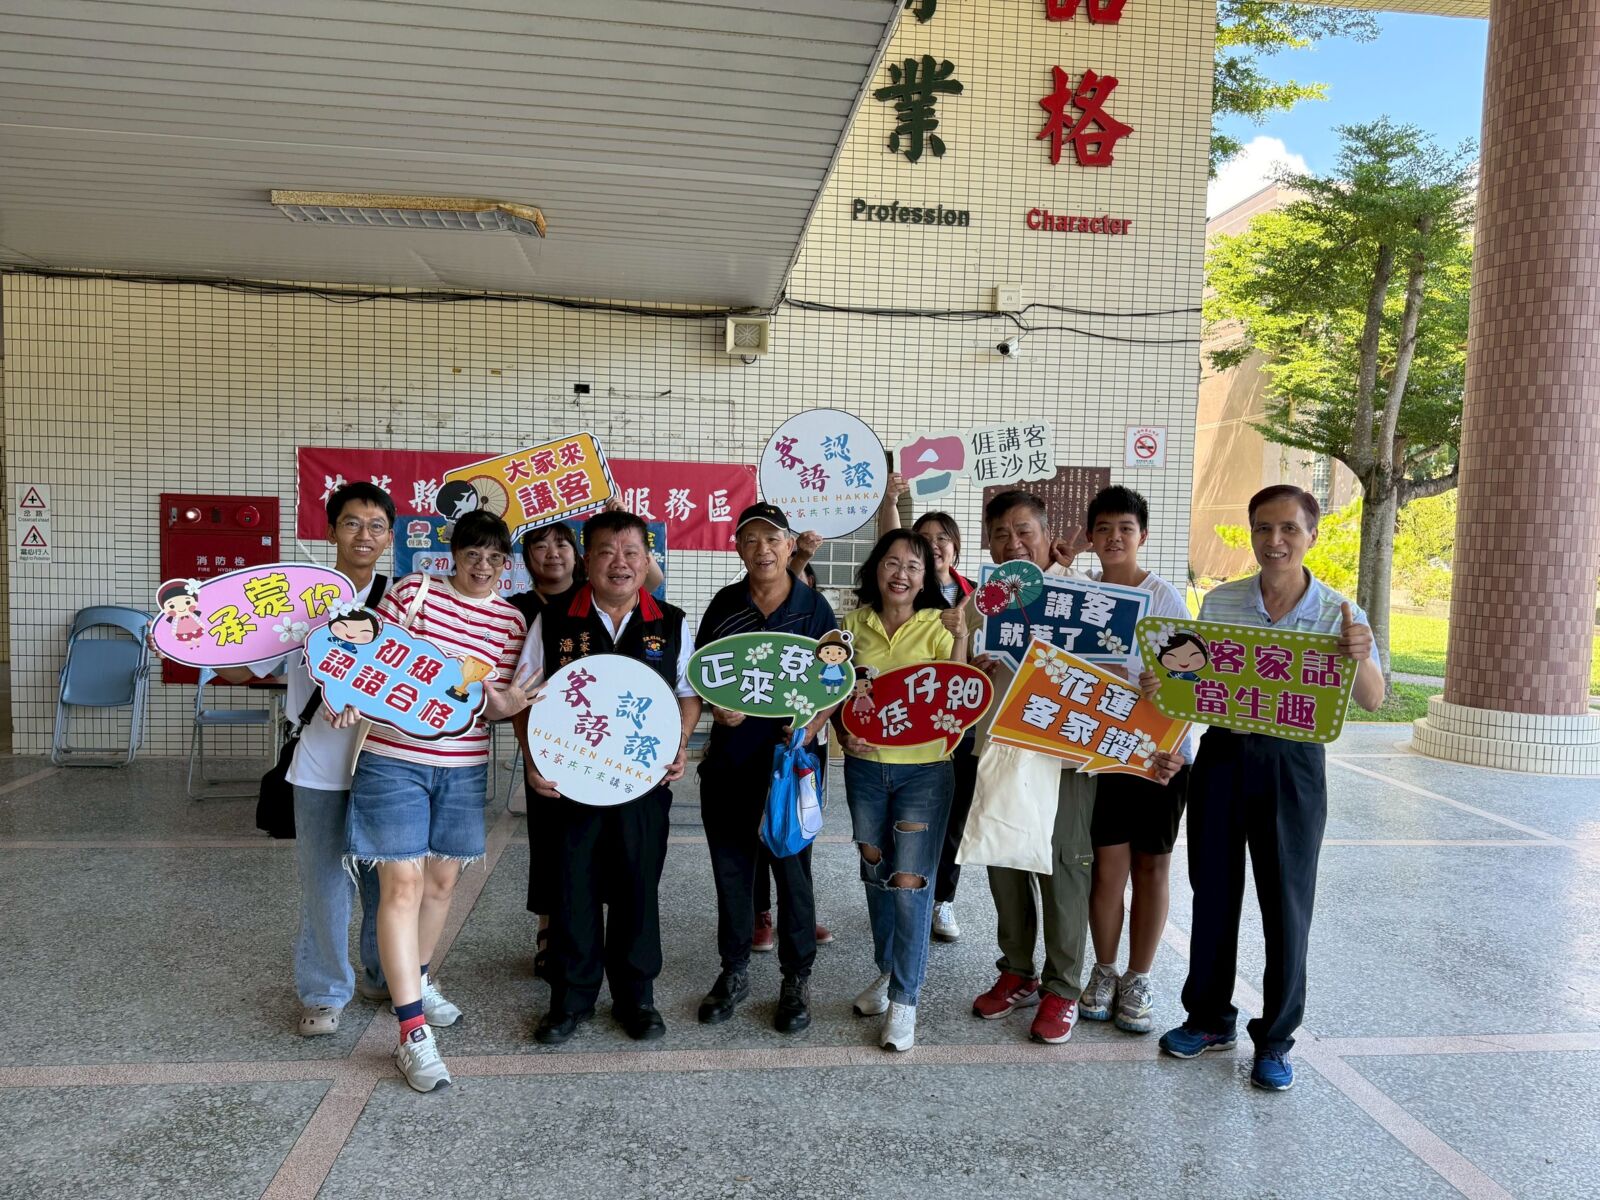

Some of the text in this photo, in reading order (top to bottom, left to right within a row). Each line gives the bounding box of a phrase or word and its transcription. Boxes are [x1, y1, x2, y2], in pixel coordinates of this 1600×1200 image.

[852, 198, 970, 227] Profession
[1026, 207, 1132, 236] Character
[504, 441, 585, 484] 大家來
[517, 470, 593, 520] 講客
[771, 492, 880, 505] HUALIEN HAKKA
[196, 555, 246, 567] 消防栓
[1044, 591, 1117, 629] 講客
[374, 638, 444, 686] 初級
[1209, 639, 1344, 688] 客家話
[317, 648, 455, 731] 認證合格
[1058, 665, 1140, 722] 花蓮
[1193, 679, 1316, 731] 當生趣
[532, 727, 653, 784] HUALIEN HAKKA
